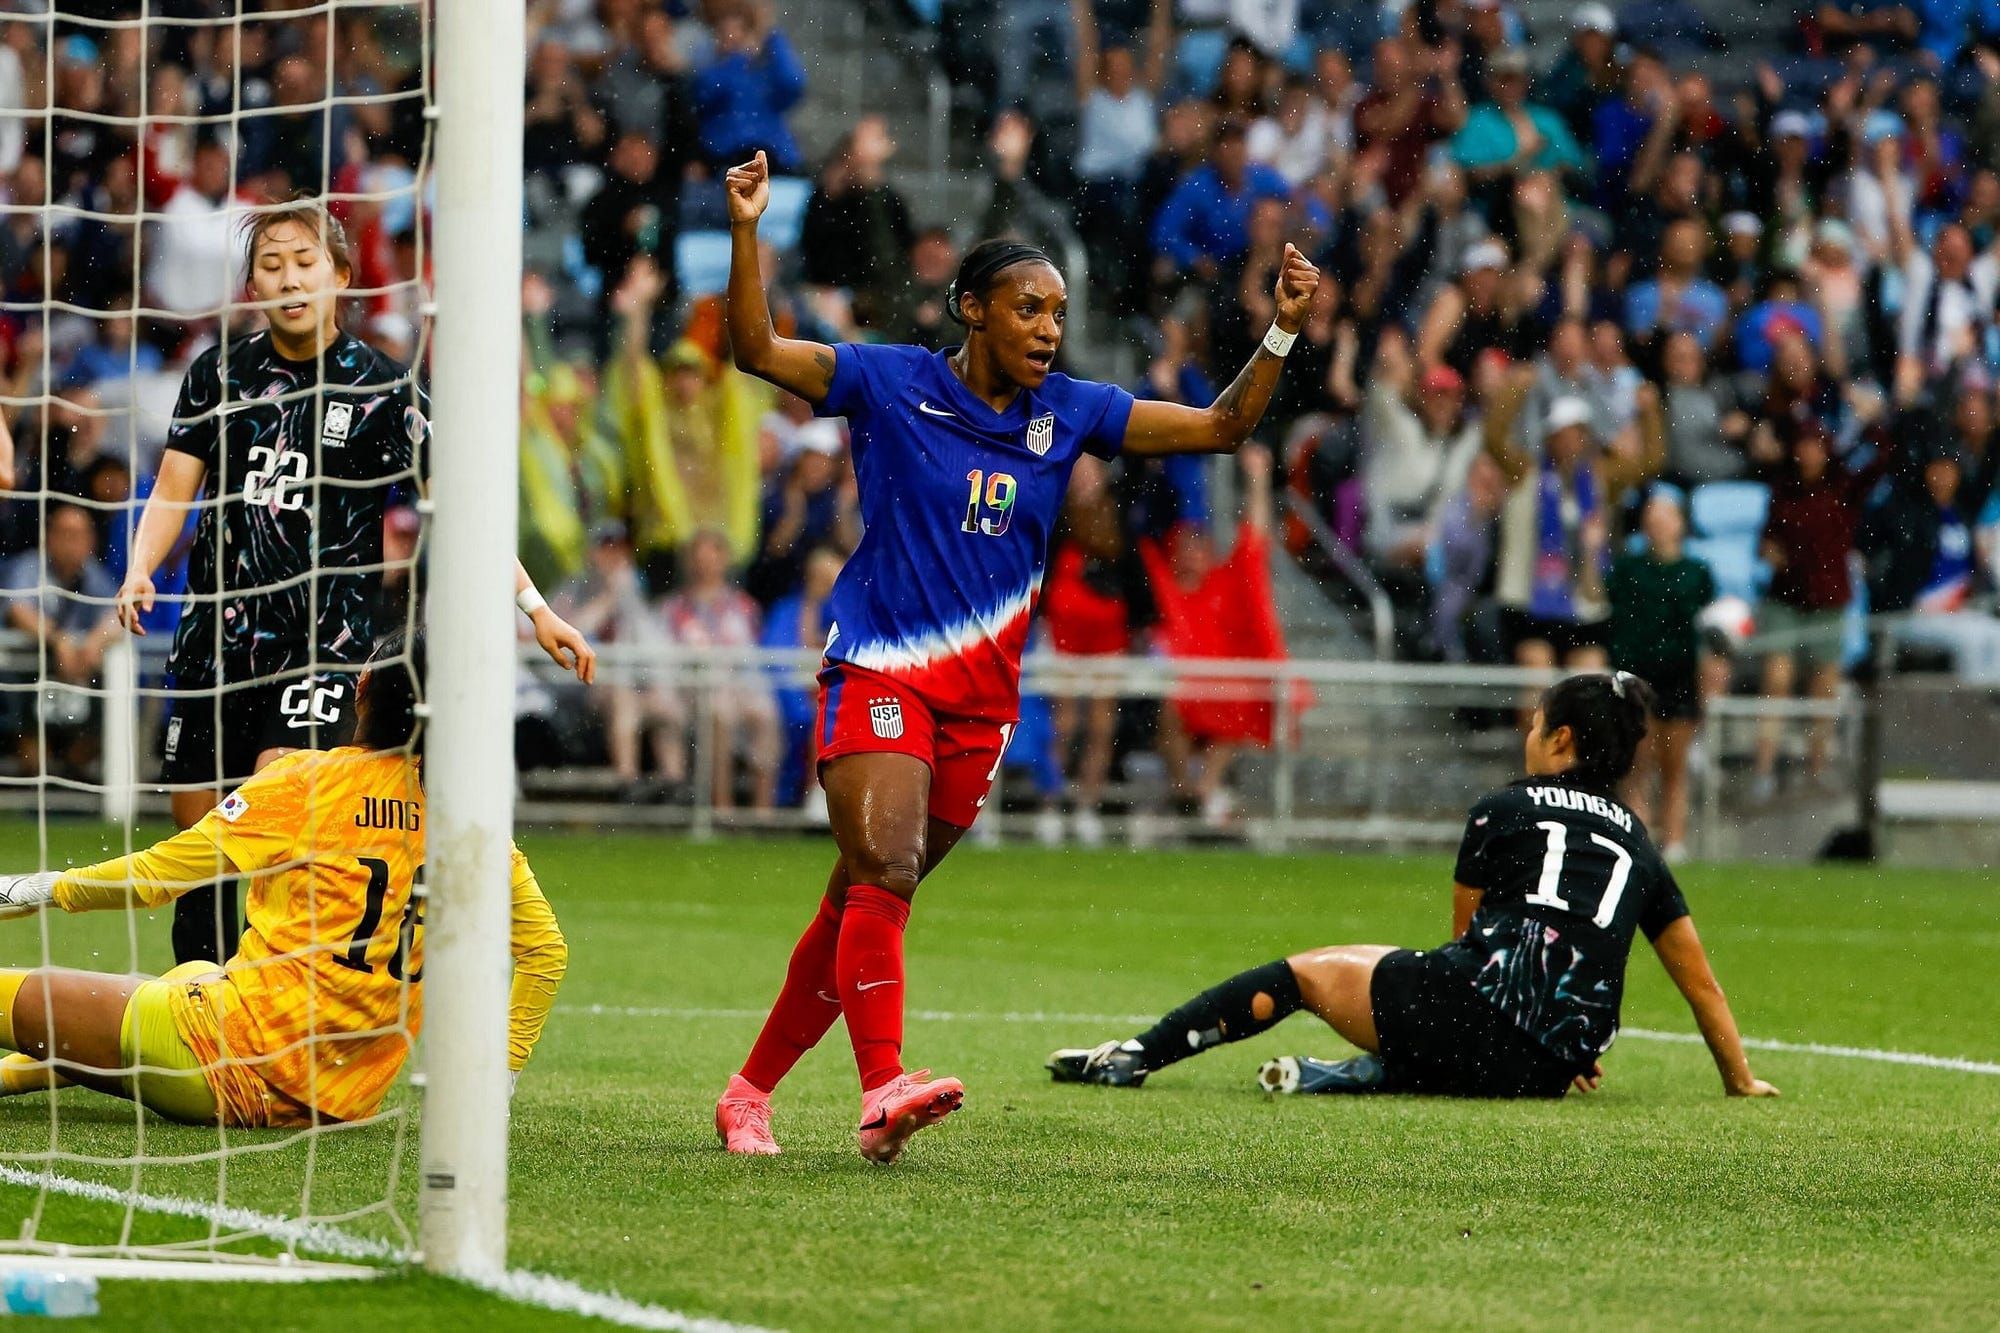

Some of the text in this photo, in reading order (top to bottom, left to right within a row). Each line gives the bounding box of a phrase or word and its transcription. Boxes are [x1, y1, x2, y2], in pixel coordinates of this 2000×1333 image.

[1030, 418, 1052, 434] USA
[243, 445, 308, 511] 22
[961, 469, 1017, 536] 19
[872, 706, 900, 721] USA
[986, 723, 1013, 781] 1
[1525, 820, 1633, 929] 17
